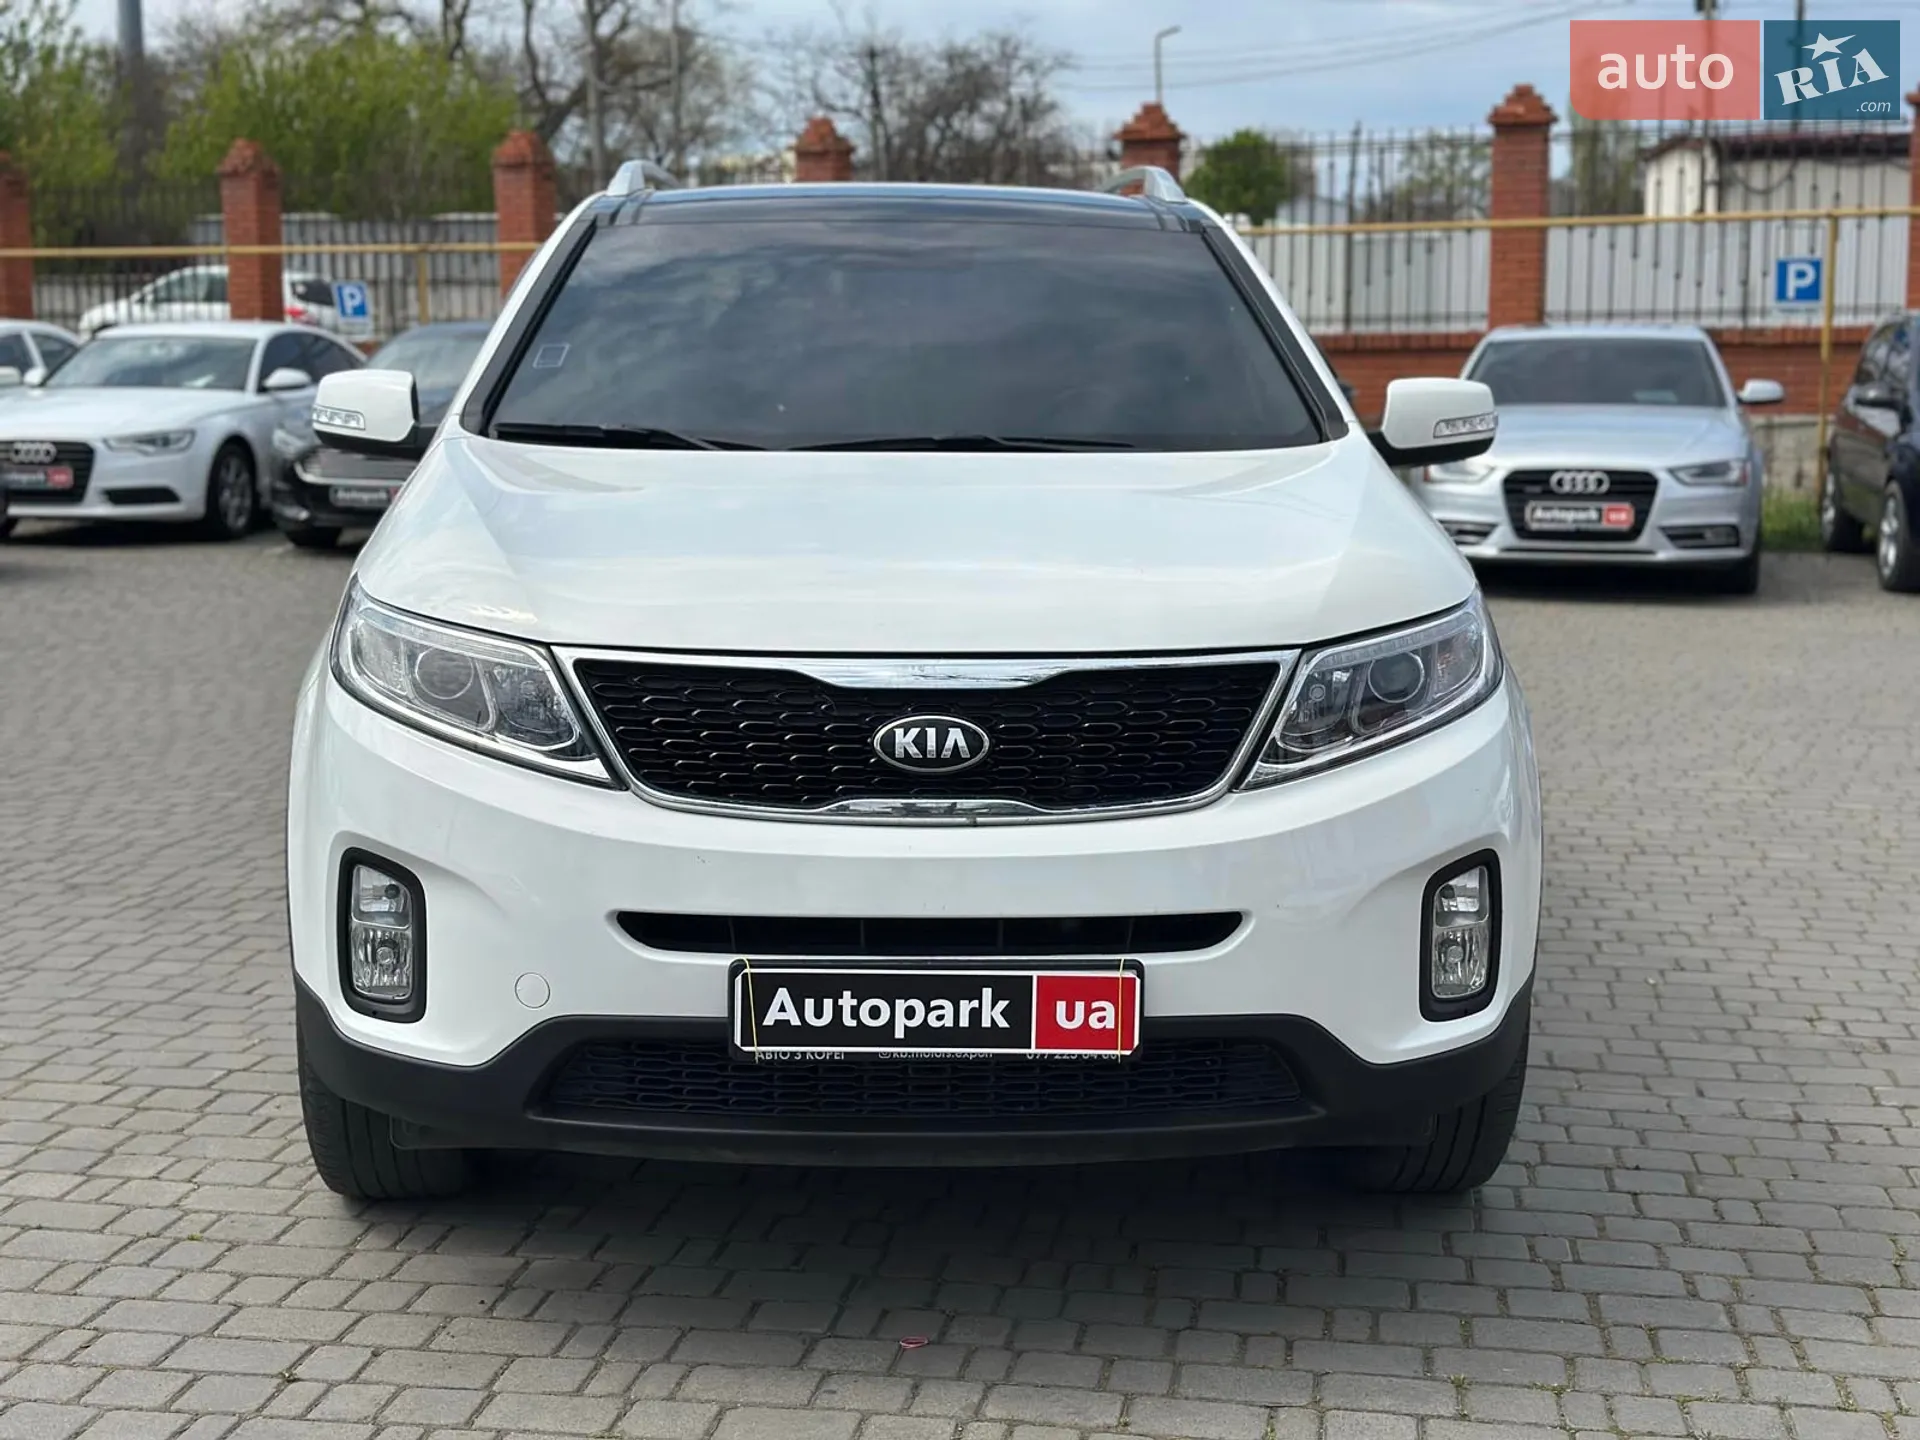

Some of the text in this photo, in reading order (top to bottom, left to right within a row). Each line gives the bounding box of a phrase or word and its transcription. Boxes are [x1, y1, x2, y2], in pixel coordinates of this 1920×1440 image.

[1786, 263, 1815, 300] P
[342, 285, 362, 316] P
[893, 727, 971, 759] KIA
[762, 987, 1115, 1039] Autopark ua
